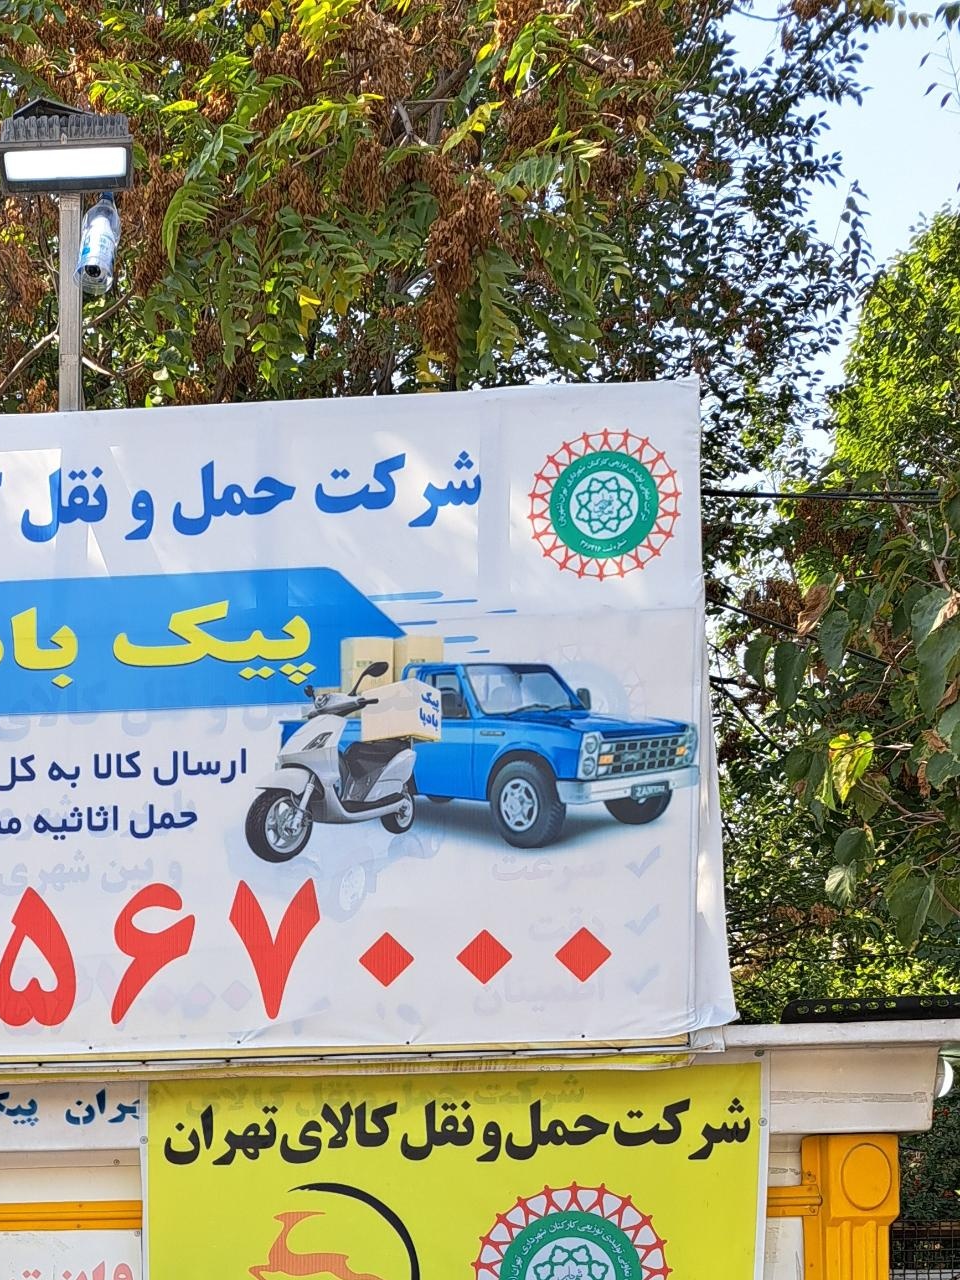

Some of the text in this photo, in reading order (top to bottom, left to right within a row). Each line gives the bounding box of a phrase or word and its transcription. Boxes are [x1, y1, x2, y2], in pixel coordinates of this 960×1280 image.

[21, 464, 107, 545] نقل
[126, 485, 155, 540] و
[173, 461, 295, 537] حمل
[314, 451, 481, 528] شرکت
[113, 600, 316, 685] پیک
[48, 762, 81, 785] به
[93, 750, 142, 779] کالا
[153, 749, 247, 785] ارسال
[36, 804, 119, 840] اثاثیه
[128, 803, 197, 836] حمل
[163, 1104, 278, 1166] تهران
[280, 1101, 397, 1164] کالای
[401, 1098, 474, 1160] نقل
[505, 1100, 608, 1161] حمل
[613, 1097, 751, 1159] شرکت
